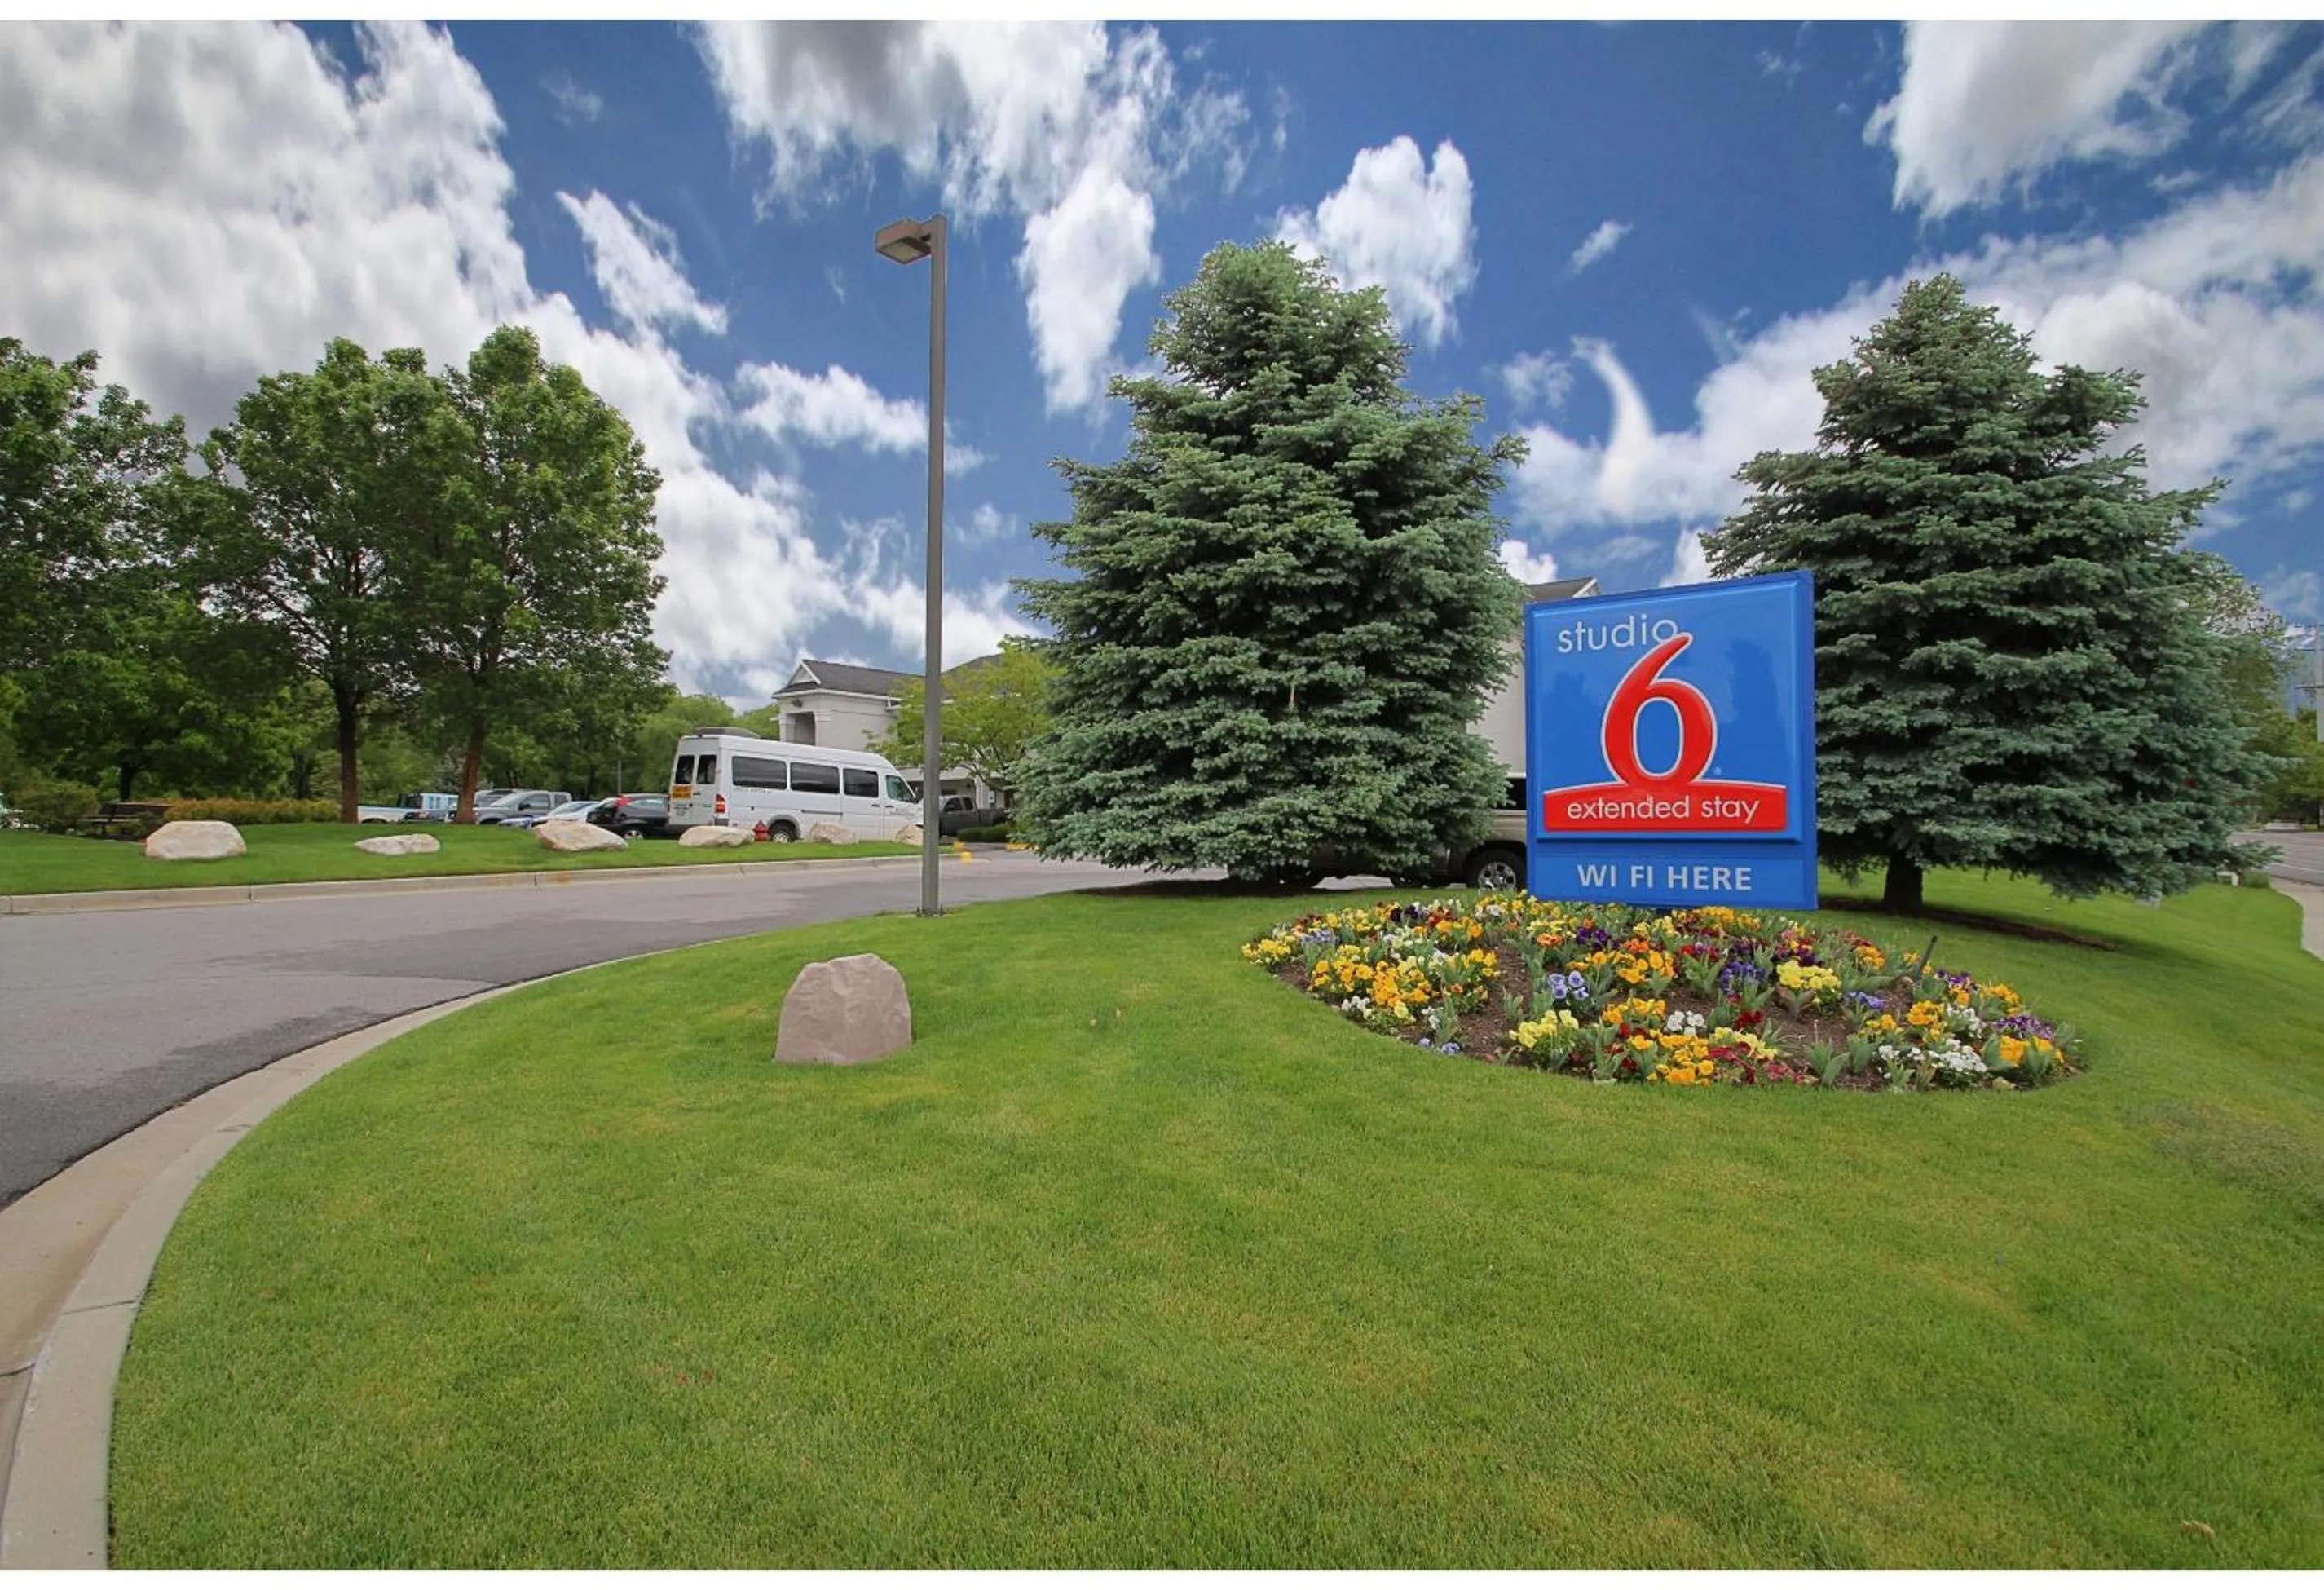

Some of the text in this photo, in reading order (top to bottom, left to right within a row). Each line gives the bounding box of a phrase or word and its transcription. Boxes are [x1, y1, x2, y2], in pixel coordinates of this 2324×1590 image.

[1558, 613, 1678, 653] studio
[1601, 631, 1718, 784] 6
[1567, 795, 1760, 824] extended stay
[1577, 864, 1753, 890] WI FI HERE
